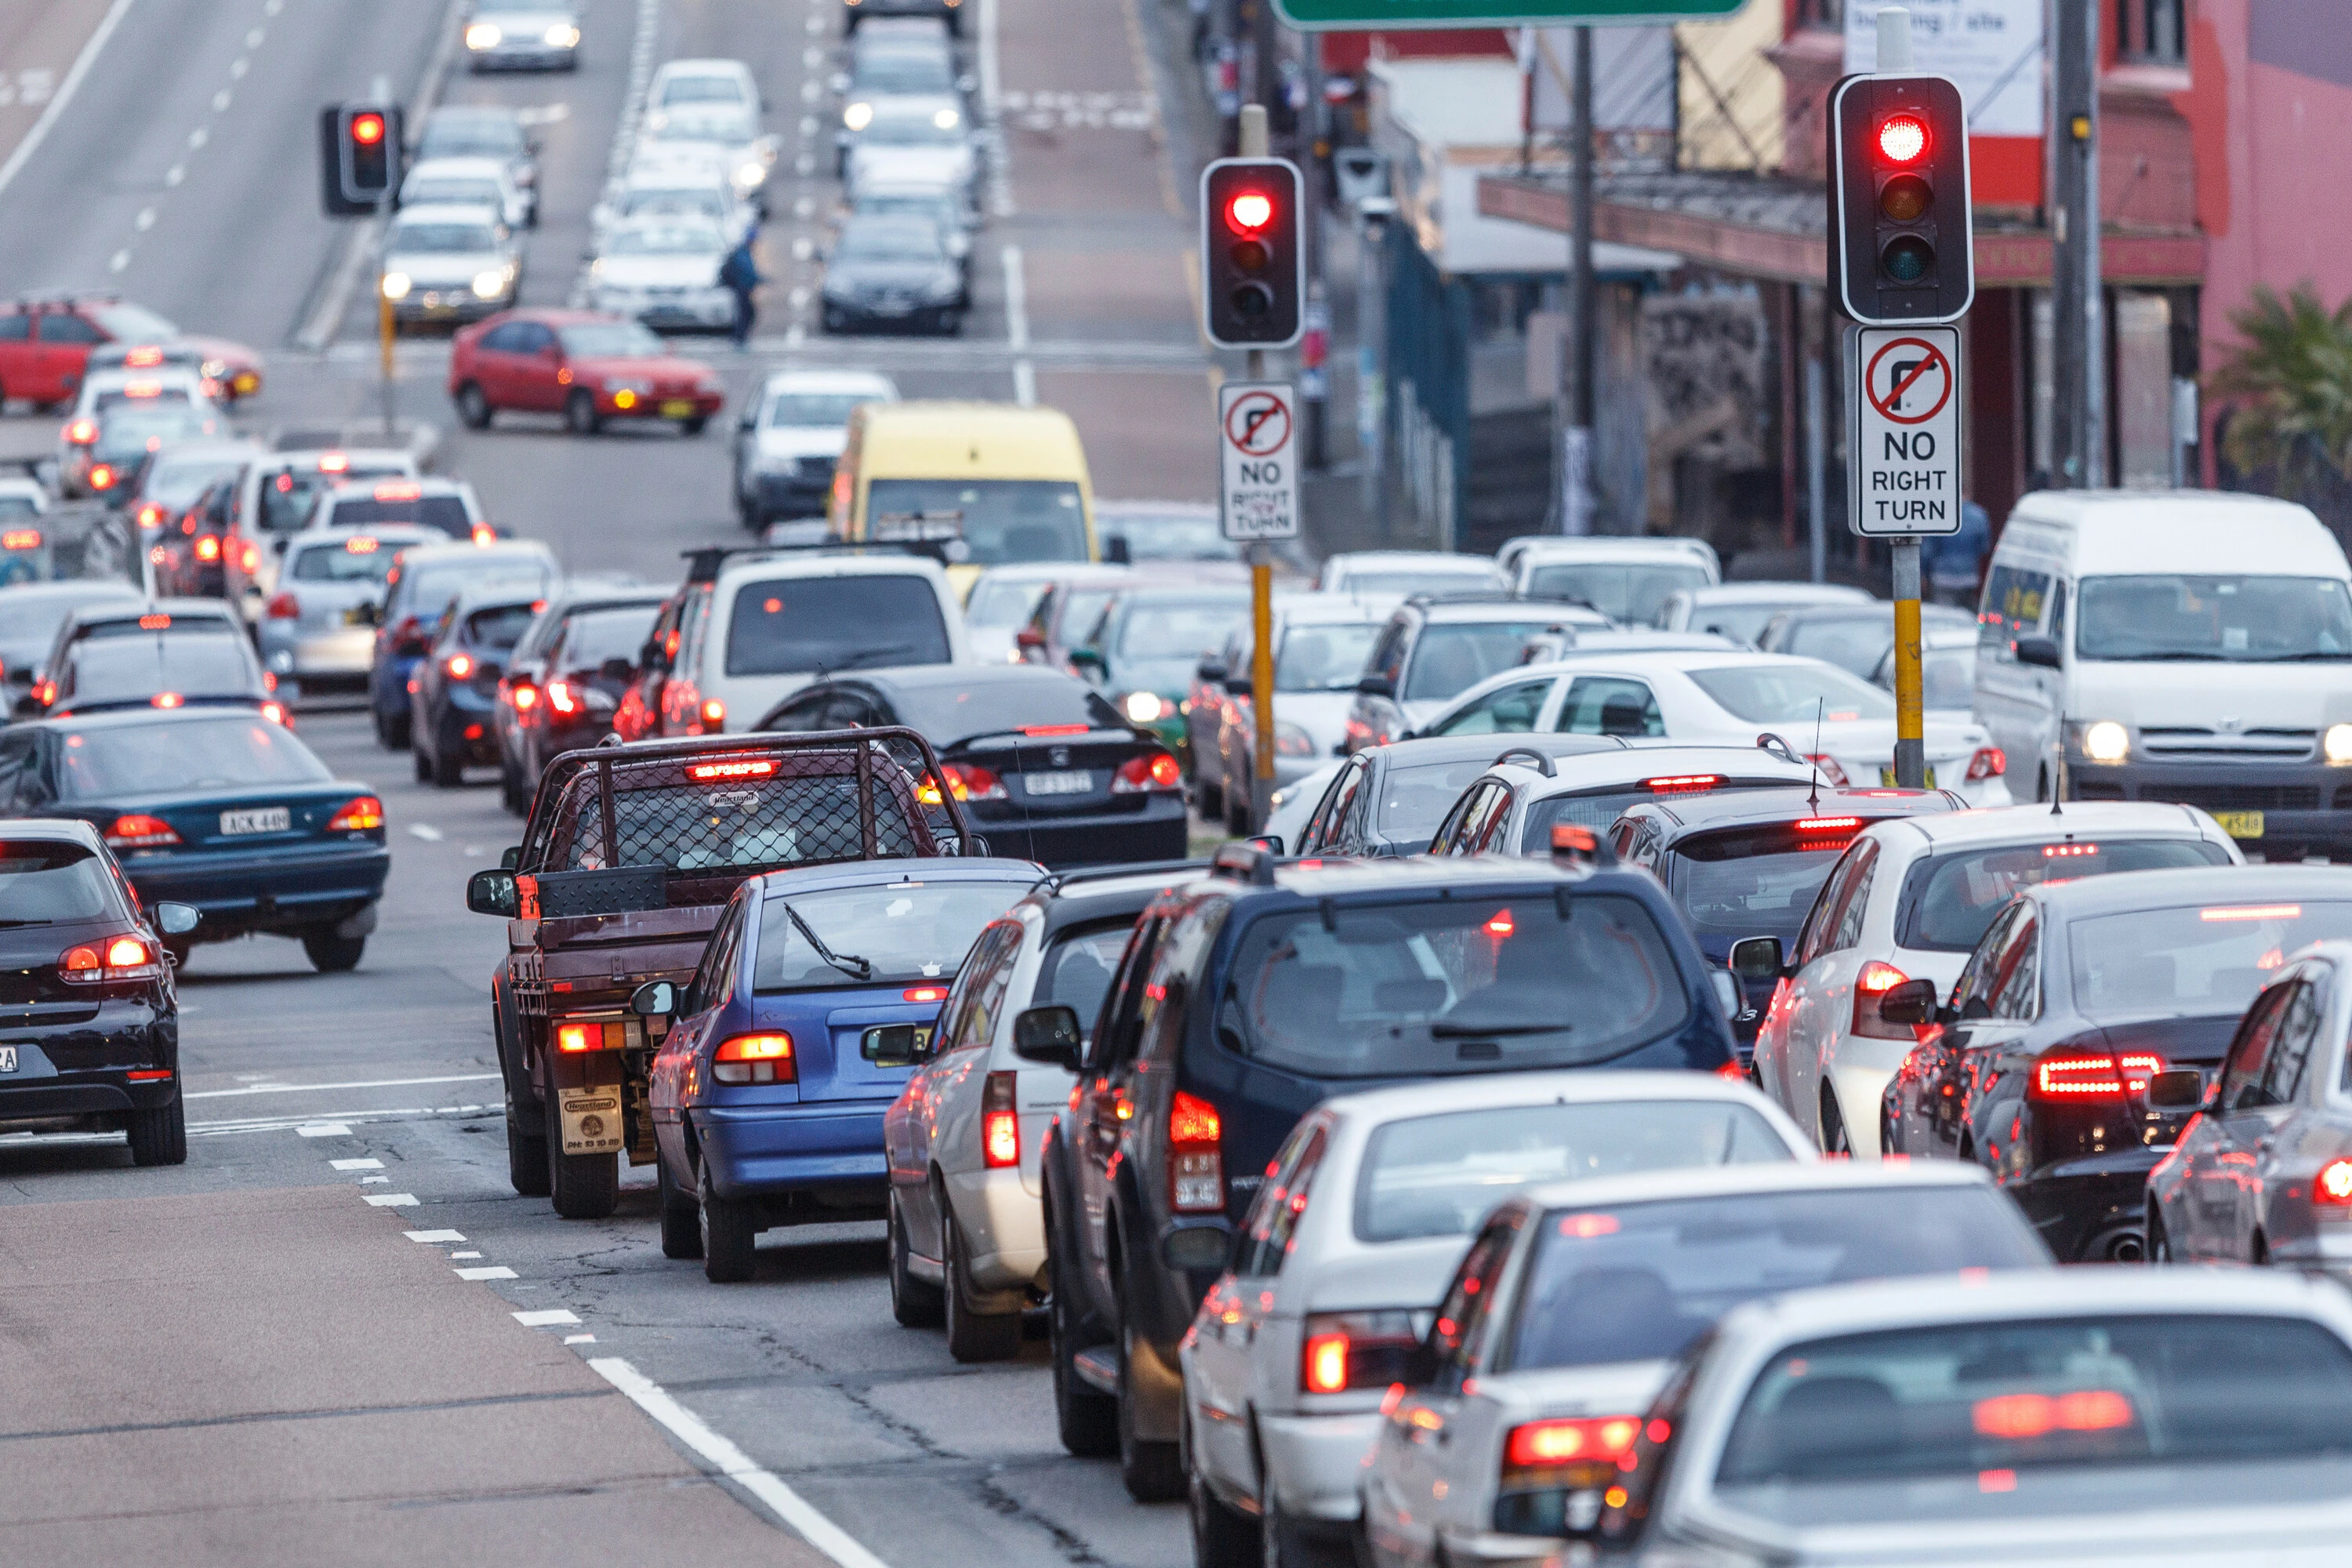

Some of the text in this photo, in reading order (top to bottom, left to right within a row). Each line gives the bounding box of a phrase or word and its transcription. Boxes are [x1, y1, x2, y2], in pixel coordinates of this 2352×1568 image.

[1884, 431, 1936, 461] NO
[1241, 461, 1281, 485] NO
[1872, 470, 1947, 491] RIGHT
[1875, 500, 1946, 520] TURN
[568, 1100, 612, 1110] Heartland
